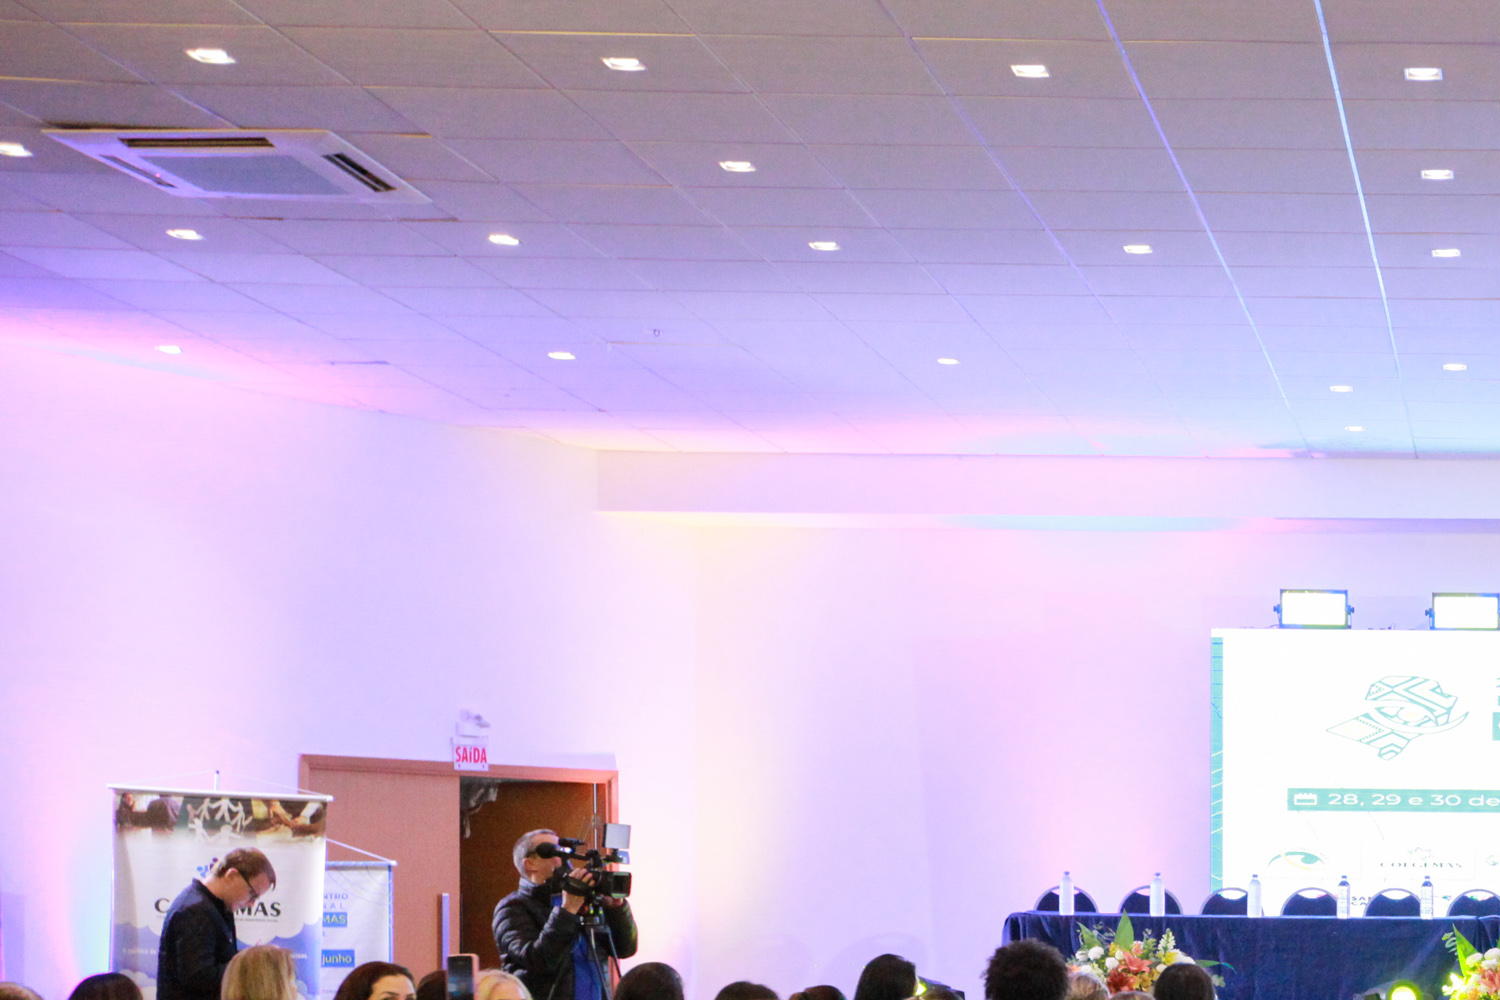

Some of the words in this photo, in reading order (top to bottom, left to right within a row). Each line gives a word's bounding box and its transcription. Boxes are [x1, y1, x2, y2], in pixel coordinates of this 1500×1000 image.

[455, 745, 487, 763] SAÍDA
[1328, 793, 1364, 806] 28,
[1371, 794, 1402, 806] 29
[1408, 797, 1424, 806] e
[1430, 794, 1462, 806] 30
[322, 953, 352, 964] junho
